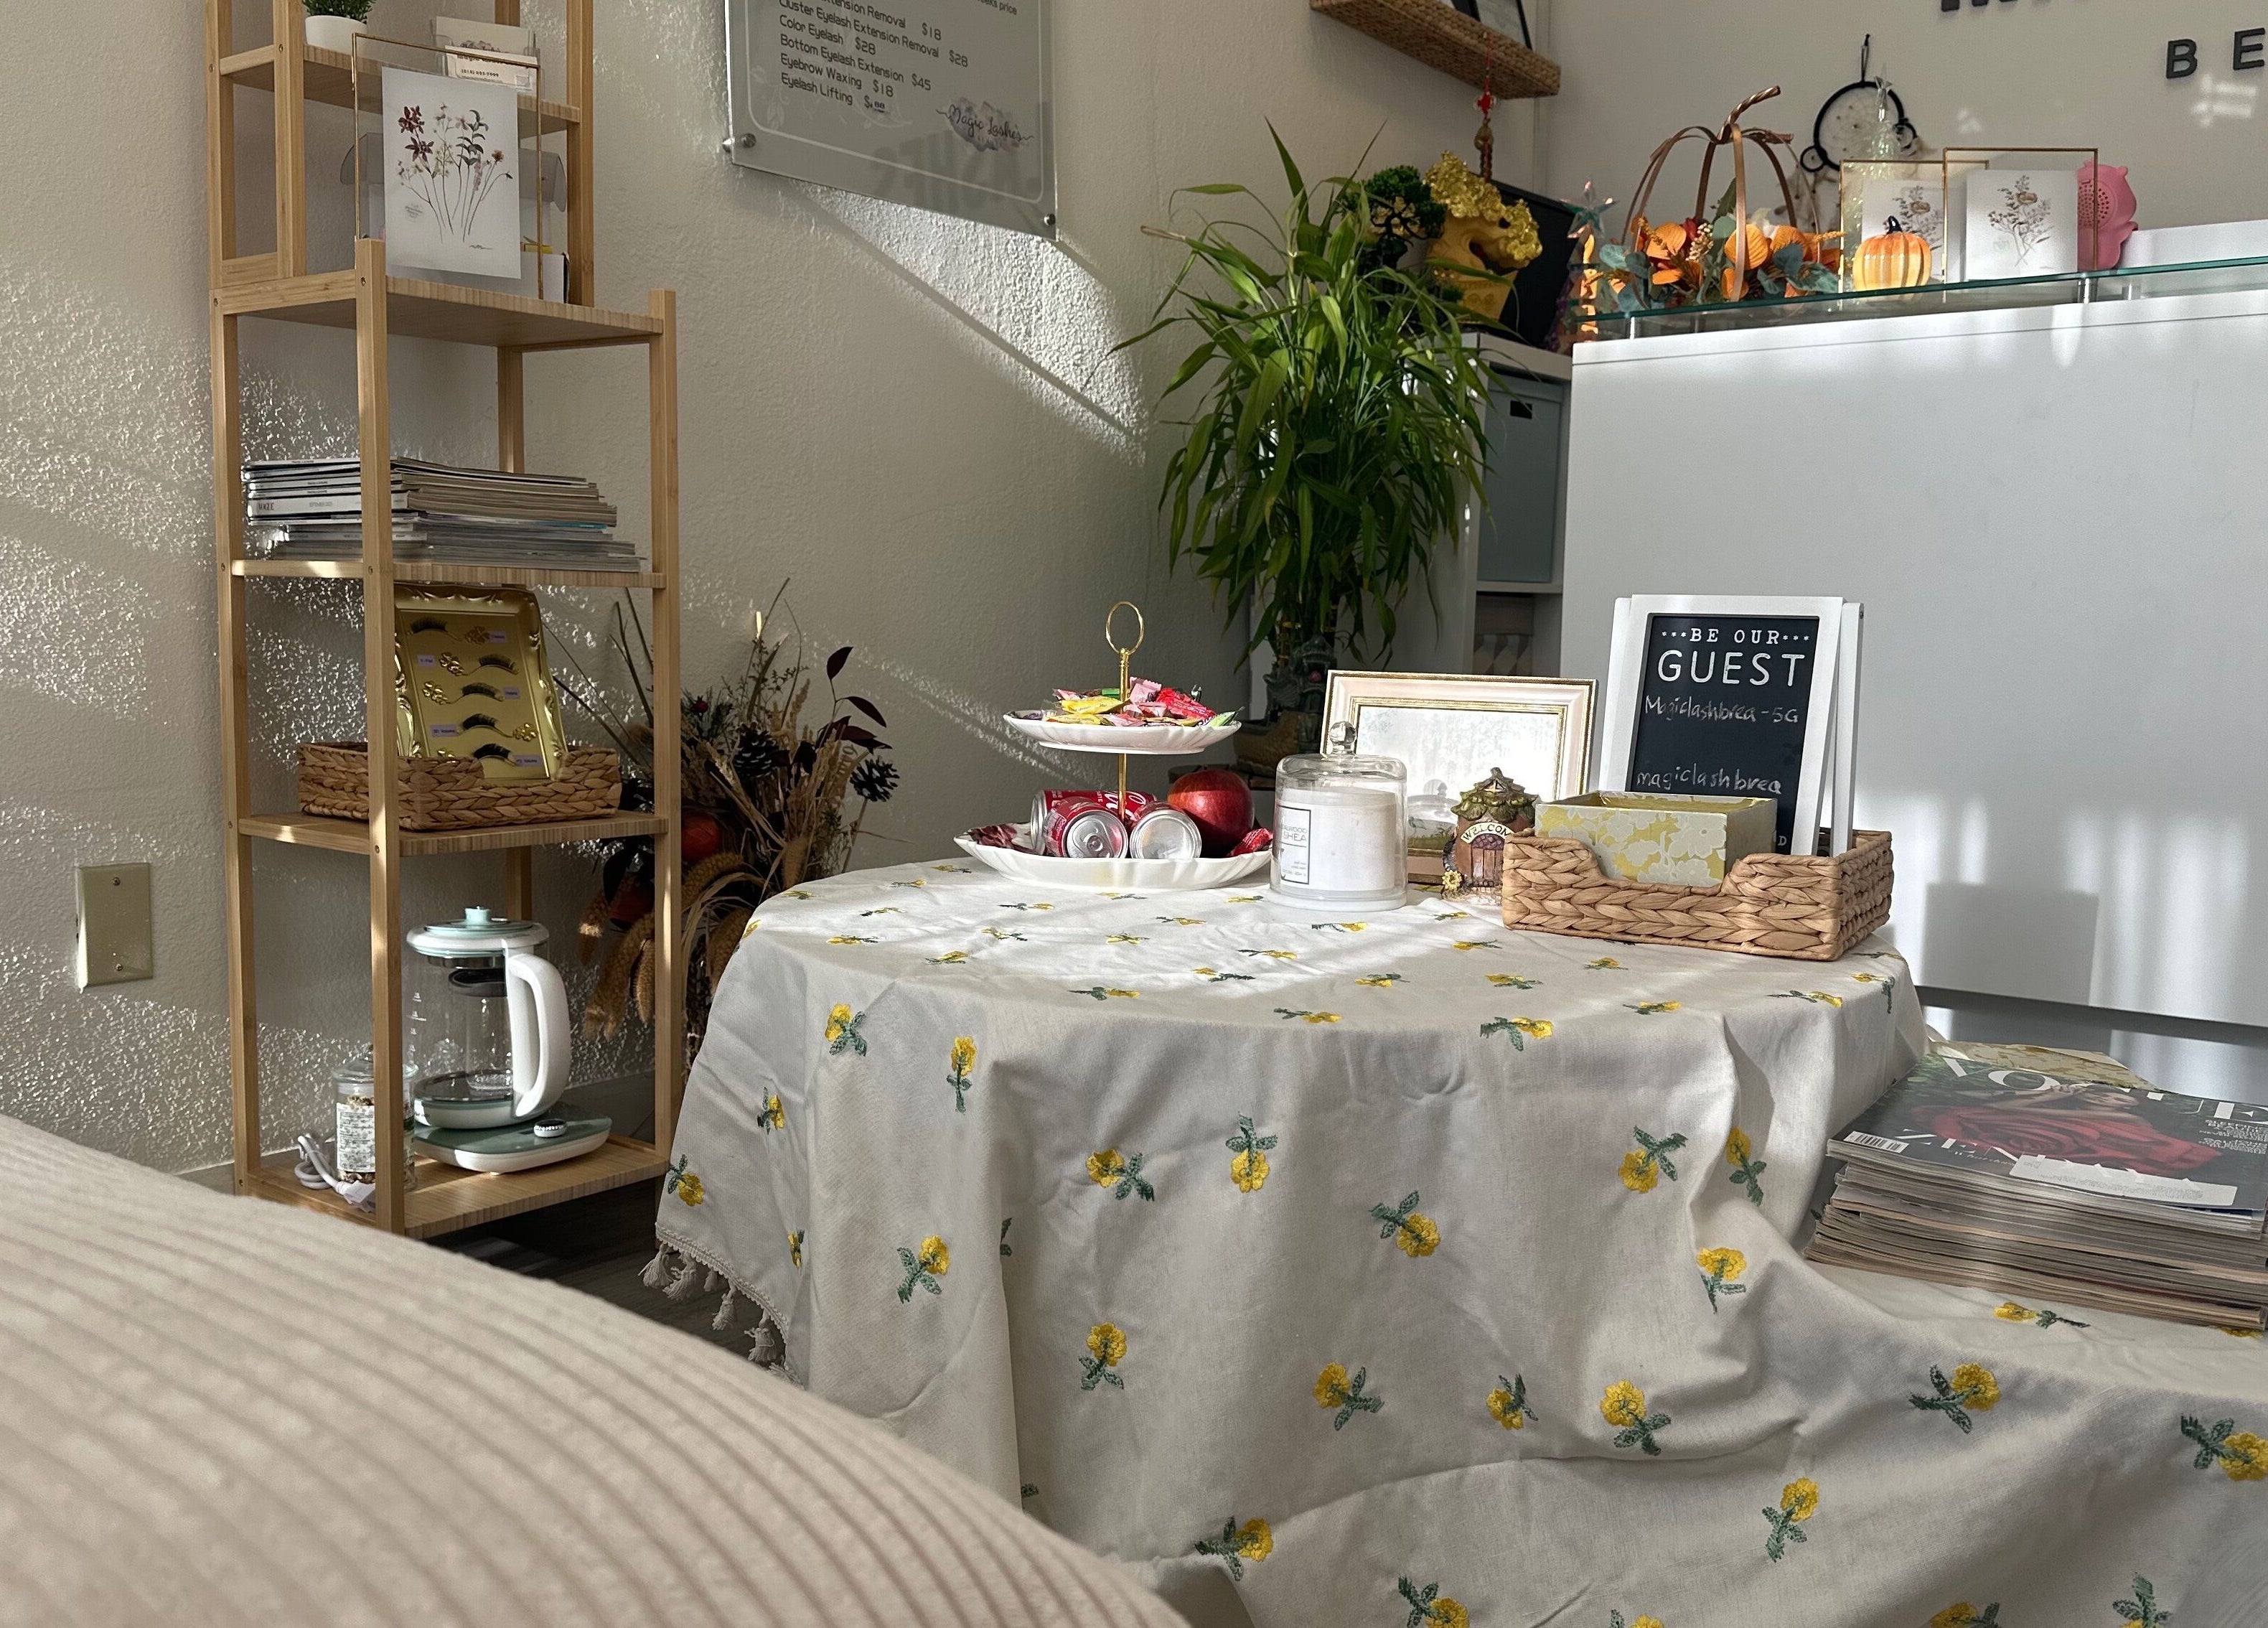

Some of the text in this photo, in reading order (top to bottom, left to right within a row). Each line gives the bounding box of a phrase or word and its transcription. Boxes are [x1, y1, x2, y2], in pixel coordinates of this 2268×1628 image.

[867, 6, 906, 29] Removal
[922, 22, 942, 41] $18
[999, 2, 1017, 15] price
[779, 14, 876, 55] Color Eyelash $28
[817, 7, 851, 30] Eyelash
[853, 19, 900, 45] Extension
[901, 36, 939, 58] Removal
[949, 50, 968, 67] $28
[780, 34, 931, 91] Bottom Eyelash Extension $45
[780, 52, 894, 98] Eyebrow Waxing $18
[781, 72, 817, 93] Eyelash
[820, 84, 853, 106] Lifting
[947, 104, 984, 137] Magic
[1690, 628, 1780, 645] BE OUR
[1658, 650, 1806, 687] GUEST
[1283, 831, 1307, 842] SHEA
[1462, 823, 1512, 841] WELCOM
